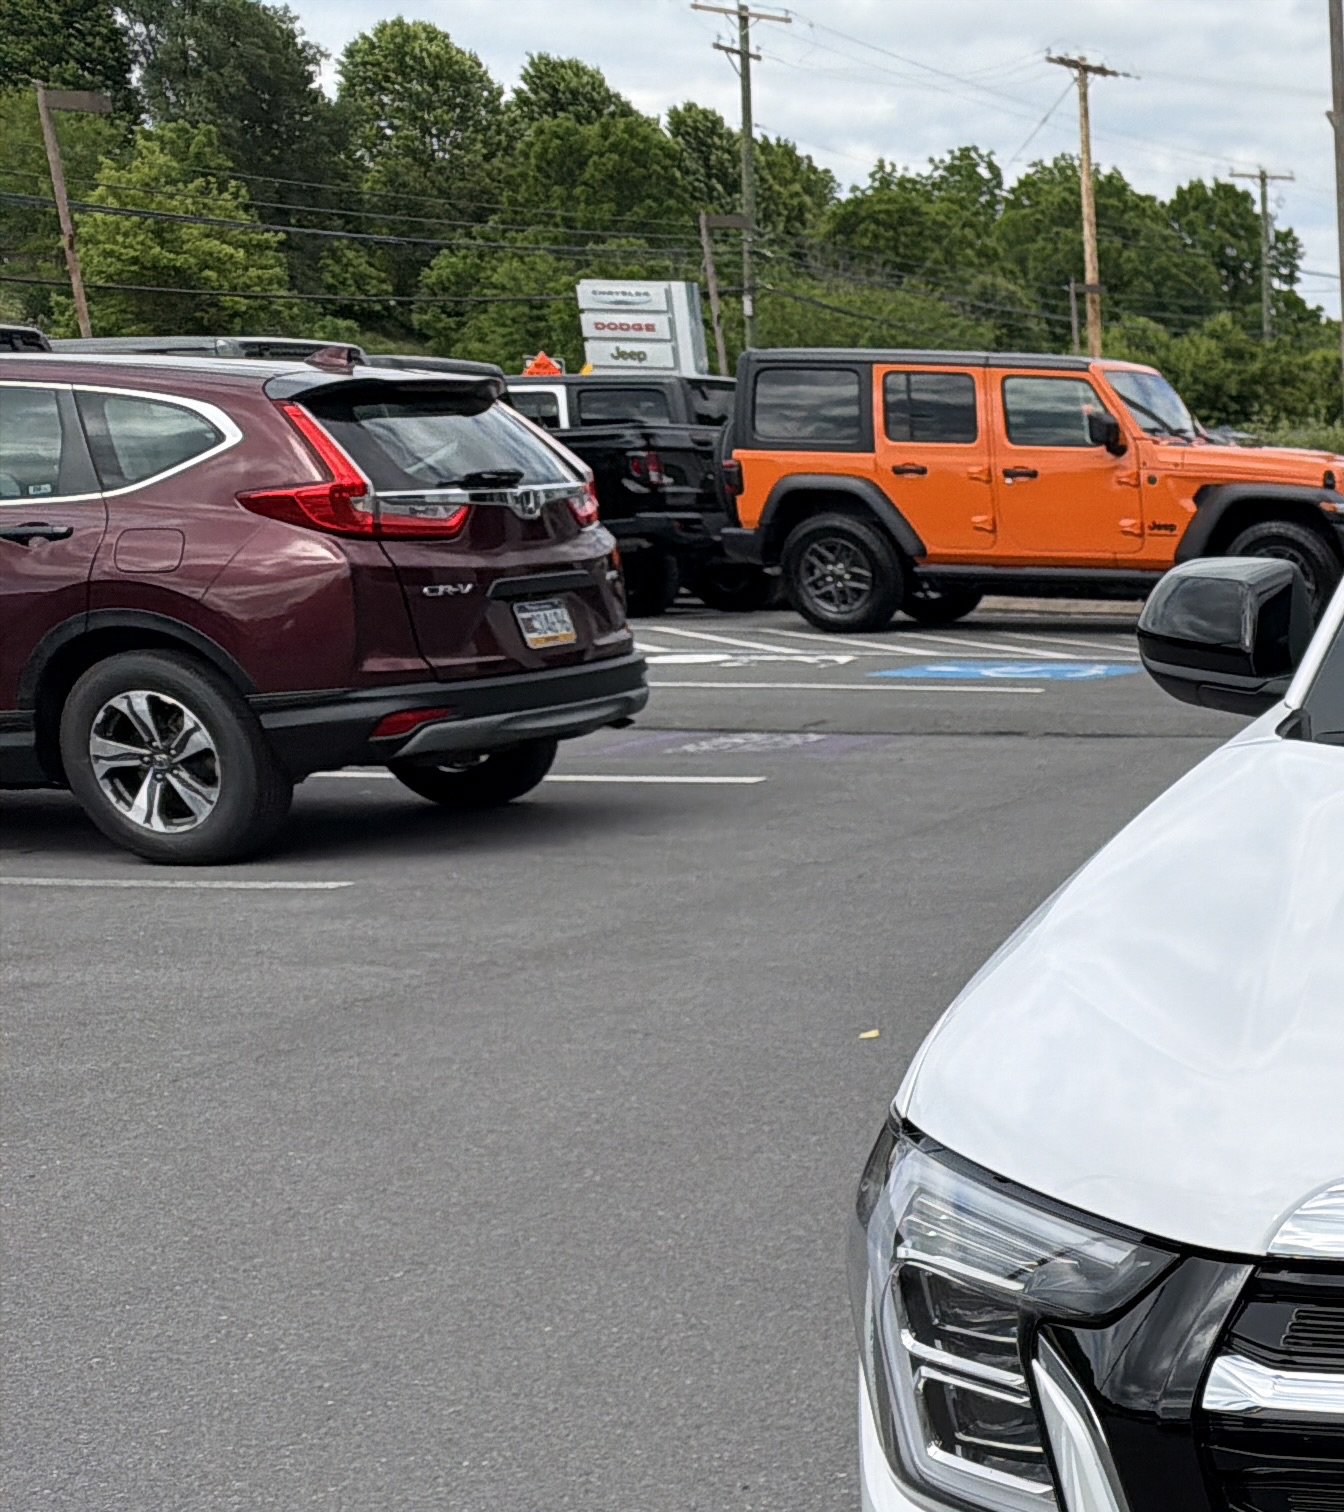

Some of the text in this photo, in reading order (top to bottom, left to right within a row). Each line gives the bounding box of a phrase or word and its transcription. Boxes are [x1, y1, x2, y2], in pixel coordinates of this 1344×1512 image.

[593, 321, 656, 332] DODGE
[610, 346, 647, 363] Jeep
[423, 583, 473, 597] CR-V
